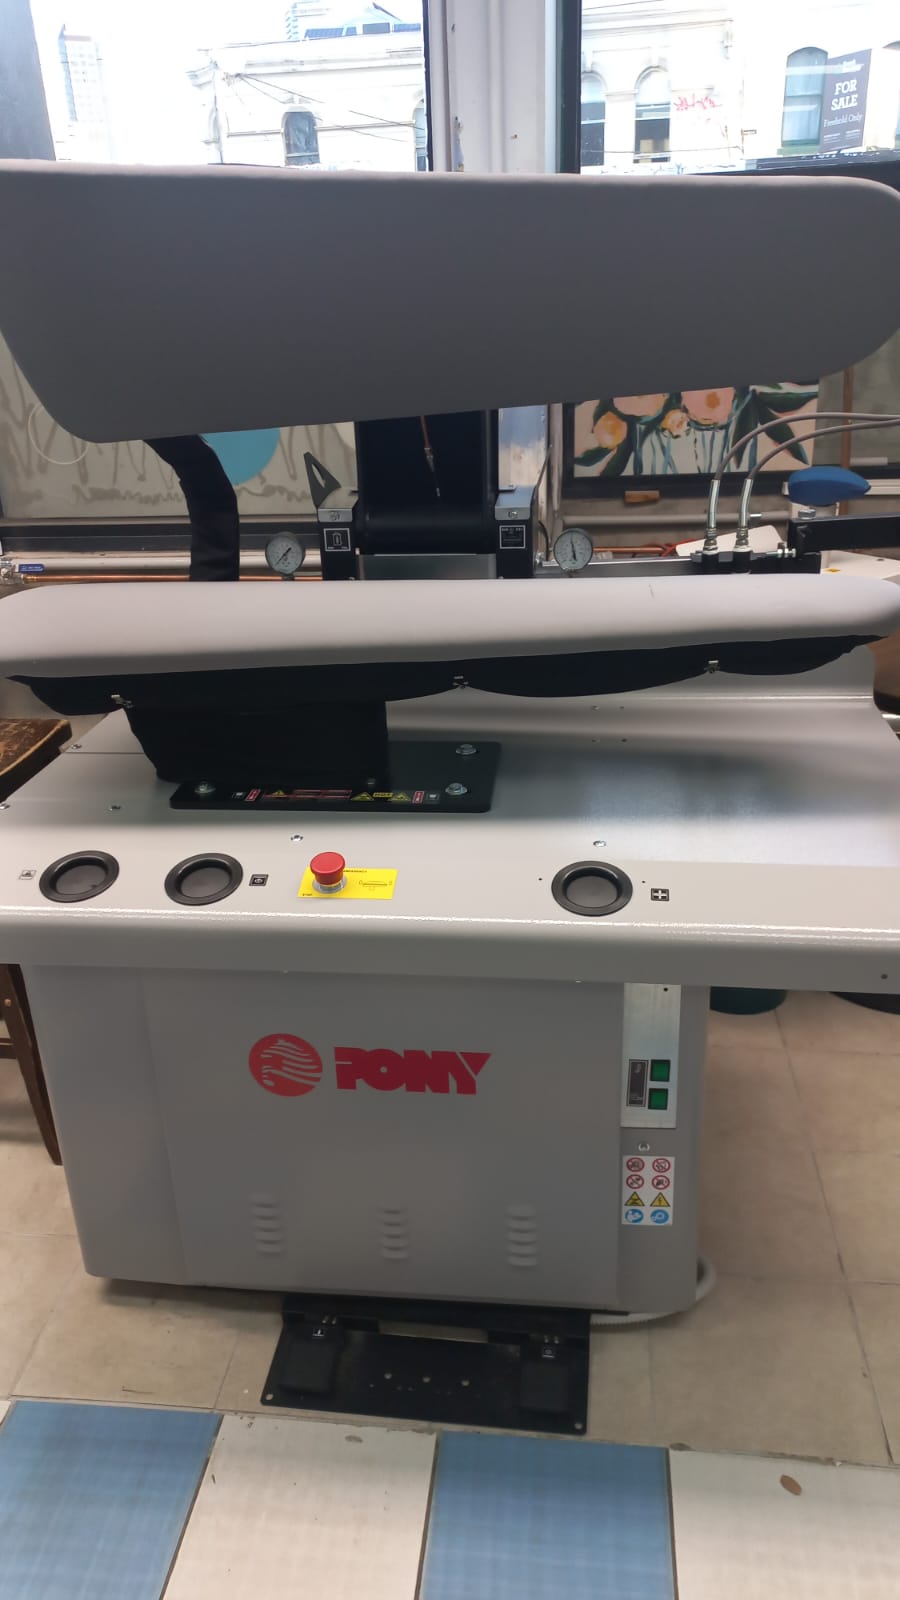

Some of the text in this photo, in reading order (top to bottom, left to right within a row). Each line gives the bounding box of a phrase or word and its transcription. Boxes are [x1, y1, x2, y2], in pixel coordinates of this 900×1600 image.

[834, 79, 857, 95] FOR
[831, 95, 858, 110] SALE
[849, 113, 862, 123] Only
[334, 1046, 492, 1095] PONY
